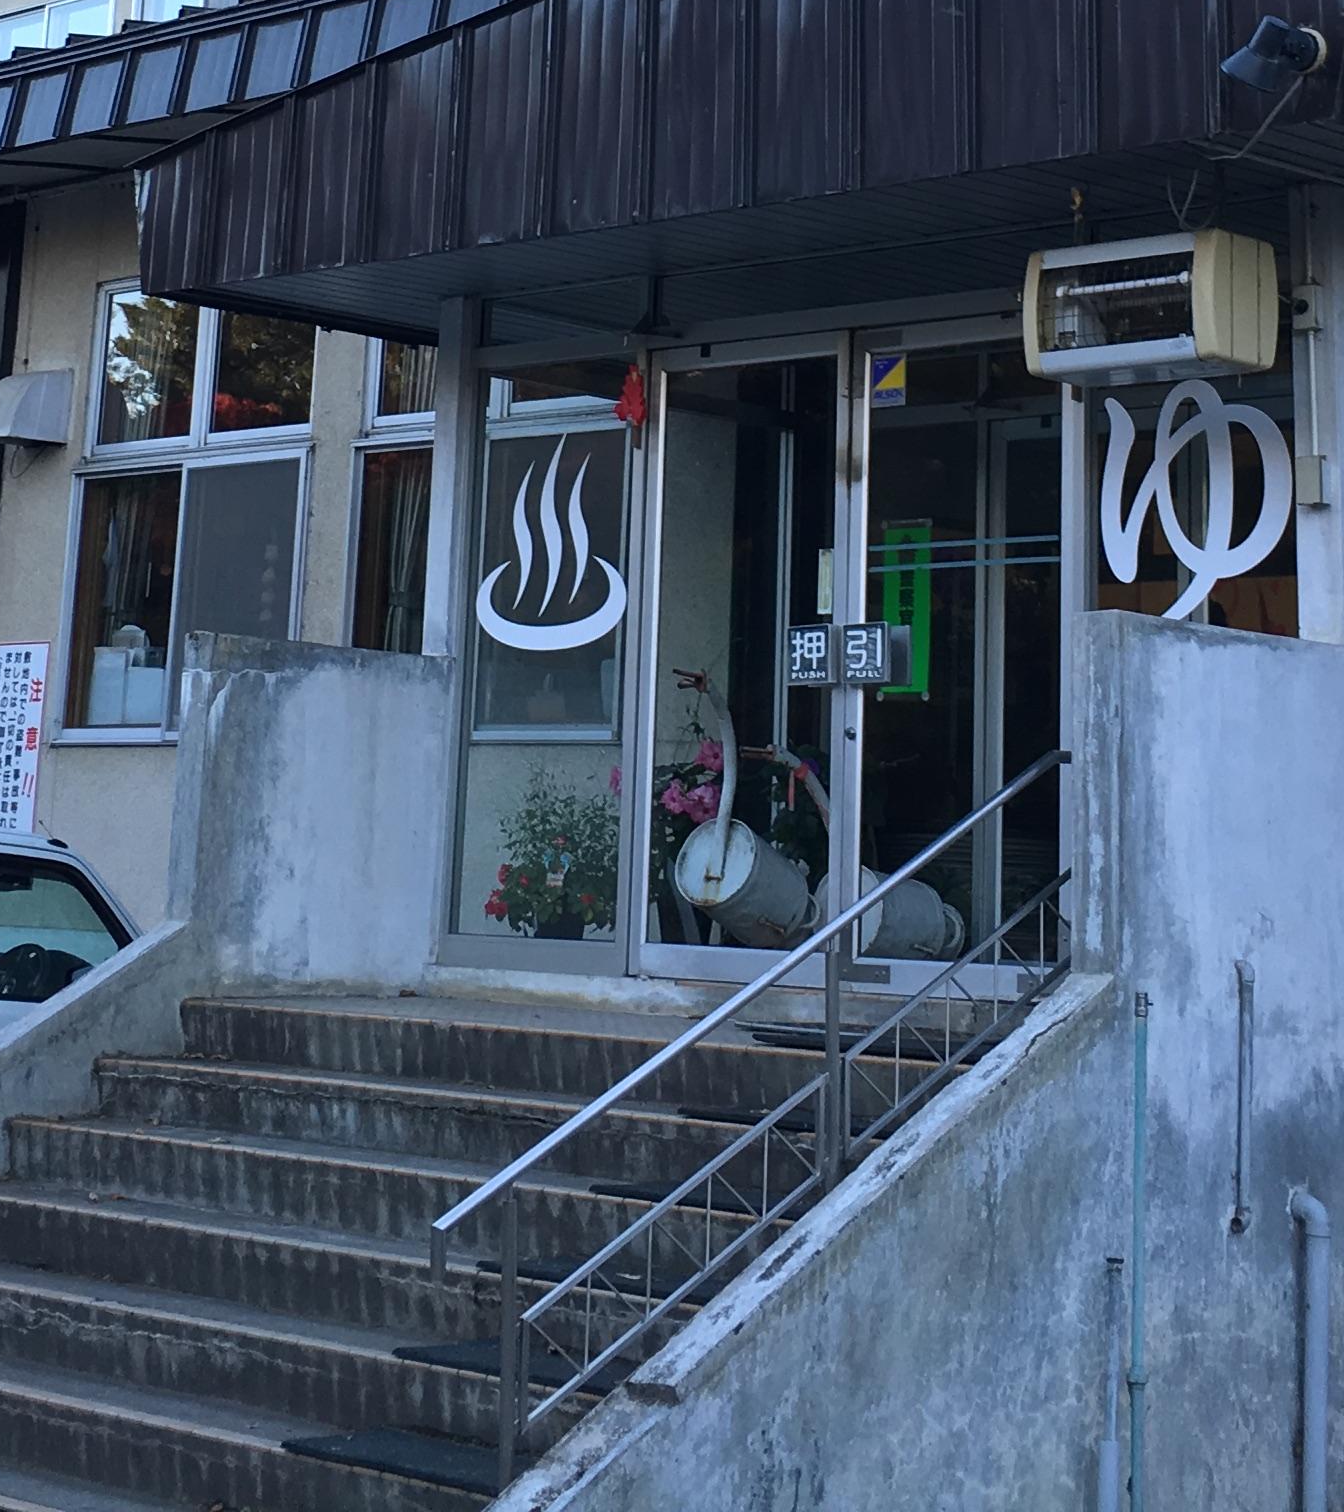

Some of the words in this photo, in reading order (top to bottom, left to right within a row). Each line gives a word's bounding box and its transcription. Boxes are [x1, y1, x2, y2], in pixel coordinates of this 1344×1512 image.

[1101, 379, 1293, 620] ゆ
[791, 631, 826, 671] 押
[846, 628, 882, 669] 引
[791, 670, 826, 680] PUSH
[846, 669, 882, 679] PULL
